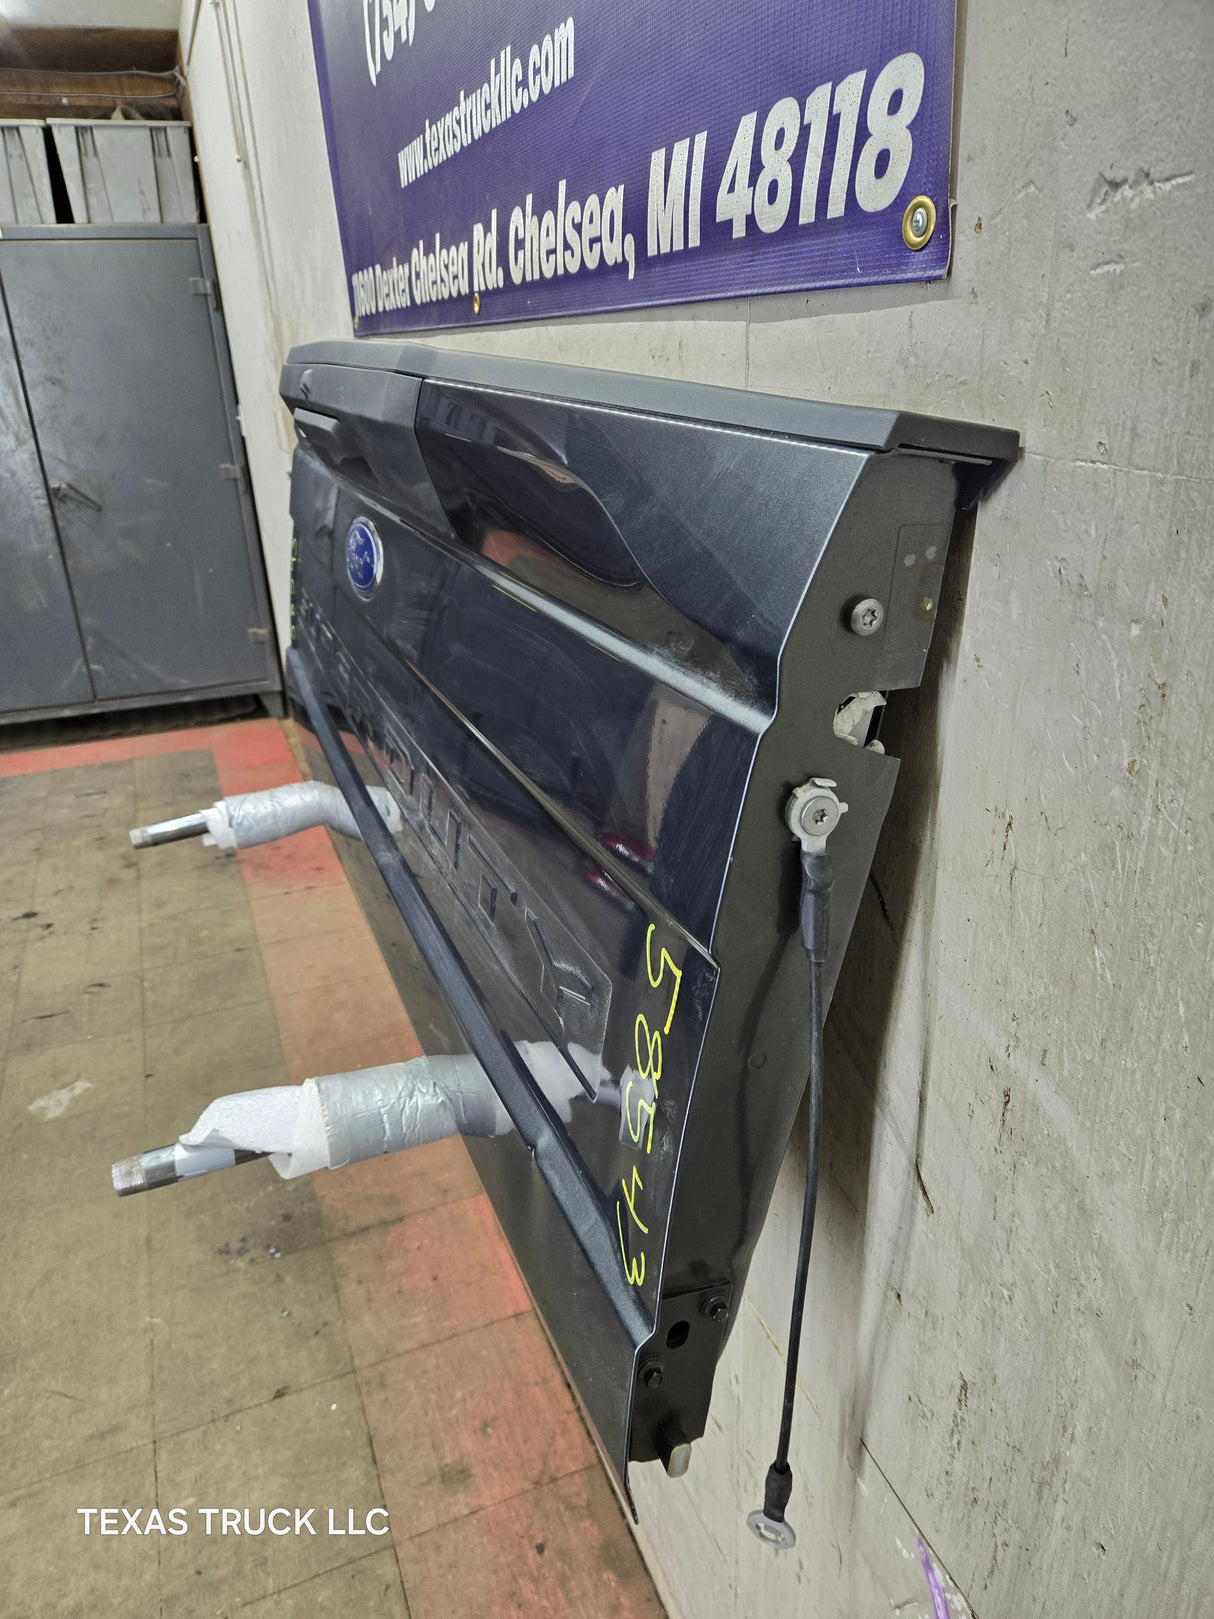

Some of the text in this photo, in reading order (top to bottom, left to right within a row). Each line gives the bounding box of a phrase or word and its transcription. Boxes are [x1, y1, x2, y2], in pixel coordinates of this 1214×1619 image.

[375, 257, 411, 313] Dexter
[411, 232, 470, 305] Chelsea
[473, 208, 504, 293] Rd.
[508, 179, 634, 285] Chelsea,
[647, 131, 708, 256] MI
[715, 52, 924, 238] 48118
[398, 16, 575, 189] www.texastruckllc.com
[616, 923, 683, 1286] 58543
